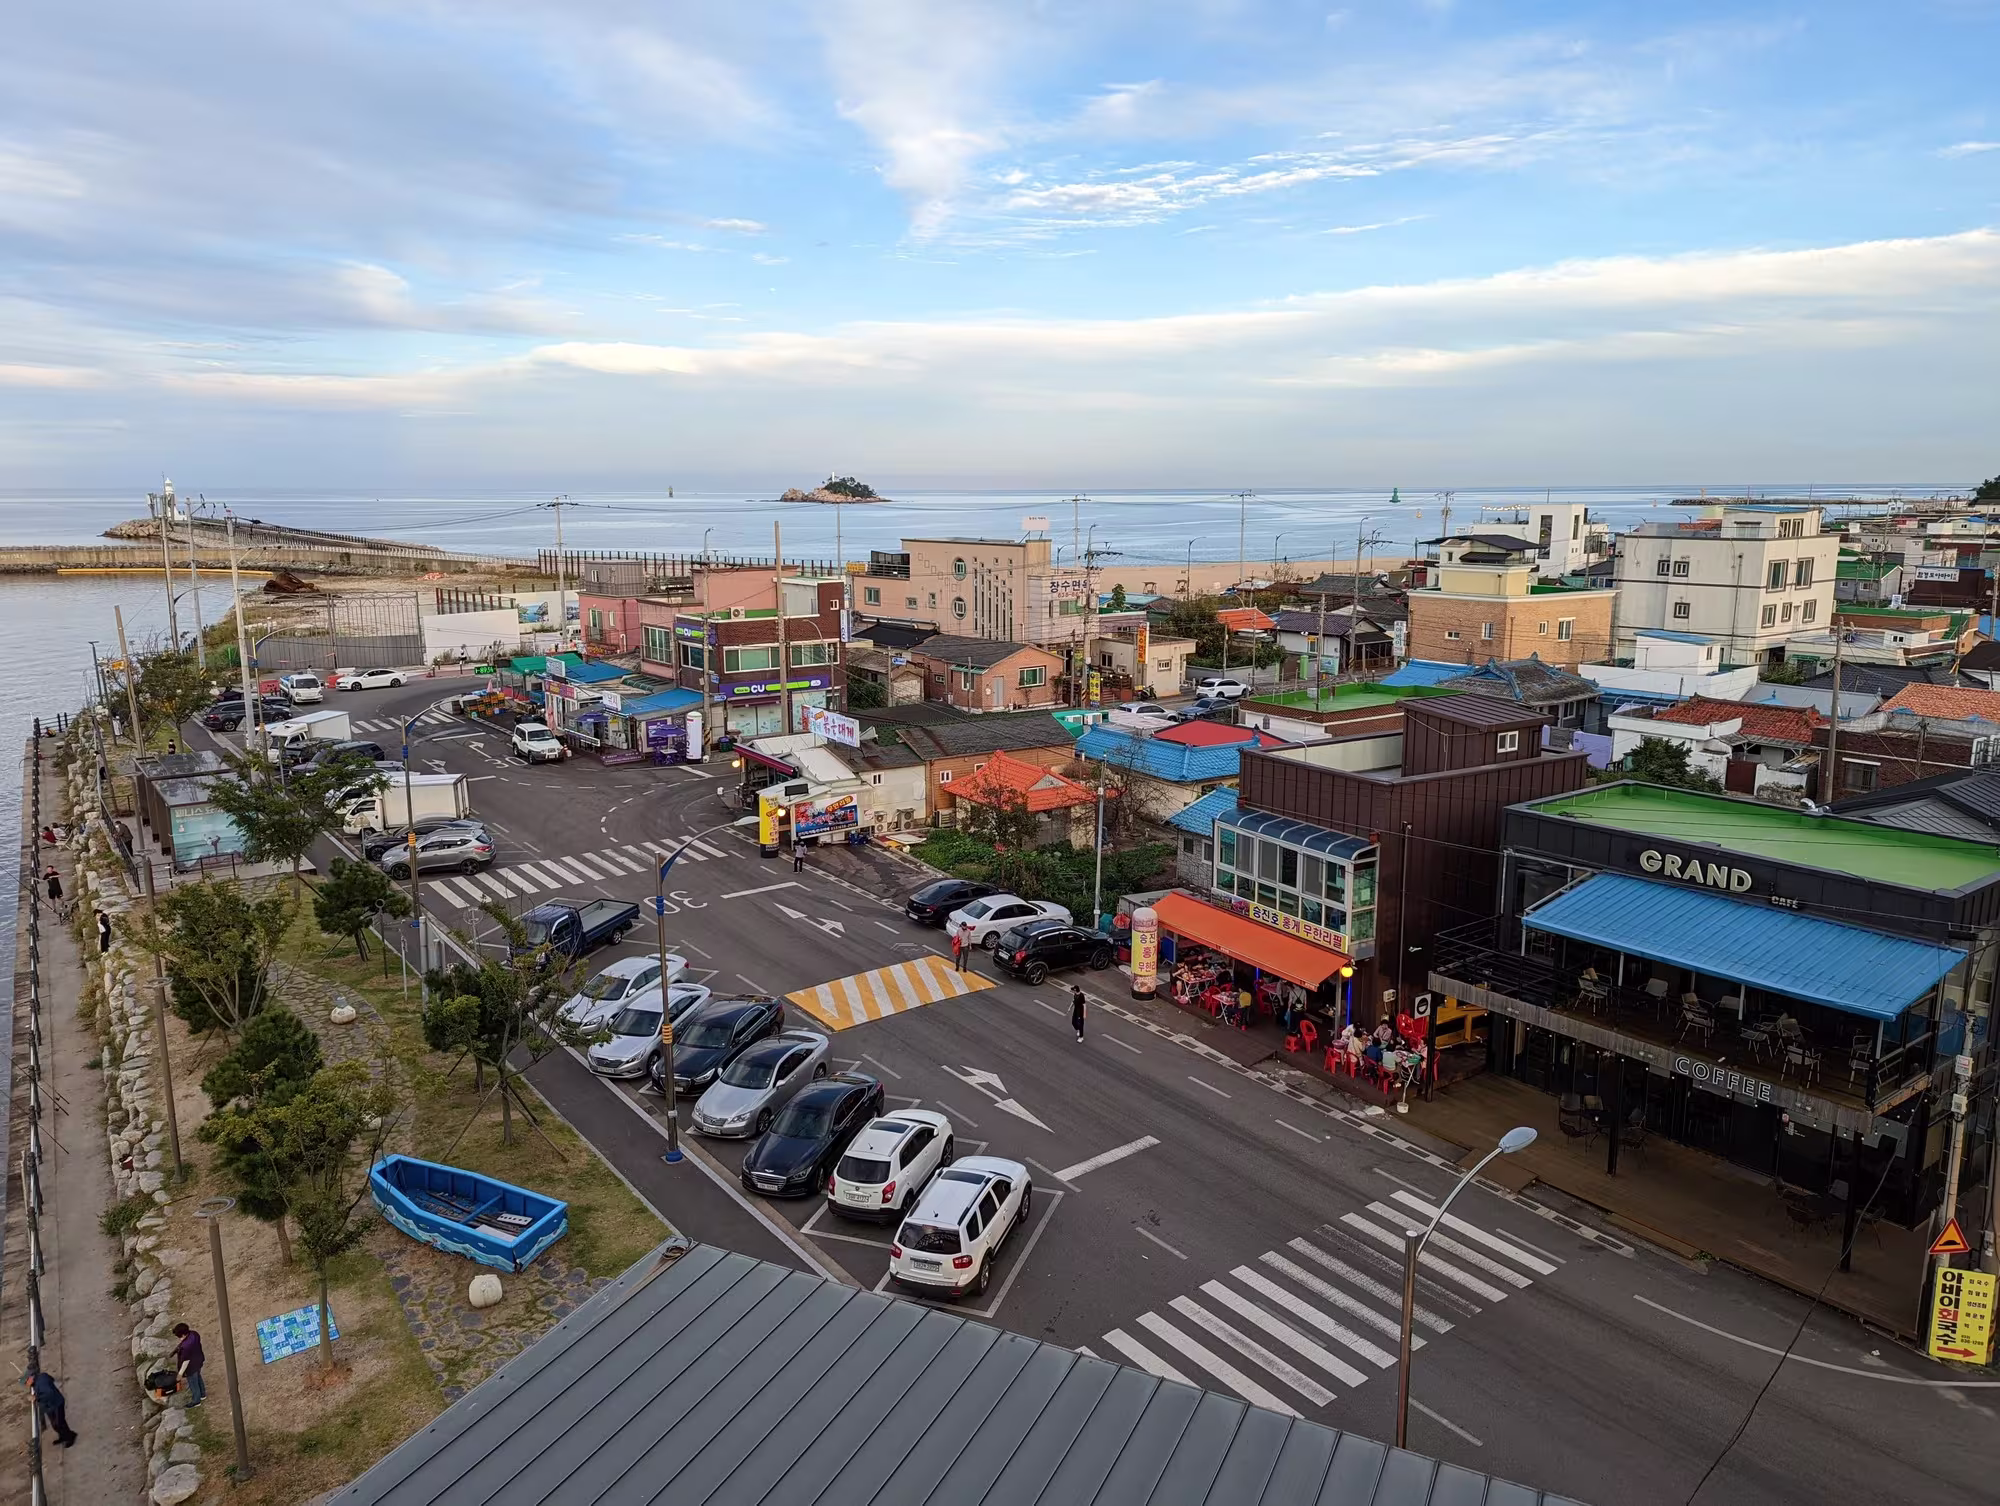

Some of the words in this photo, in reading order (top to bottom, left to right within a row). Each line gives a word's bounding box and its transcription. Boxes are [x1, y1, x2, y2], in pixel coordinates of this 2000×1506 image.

[751, 684, 765, 693] CU
[486, 757, 529, 769] 30
[1639, 850, 1752, 893] GRAND
[1253, 906, 1279, 926] 승진호
[1283, 916, 1300, 934] 홍게
[1303, 924, 1342, 950] 무한리필
[1675, 1056, 1772, 1102] COFFEE
